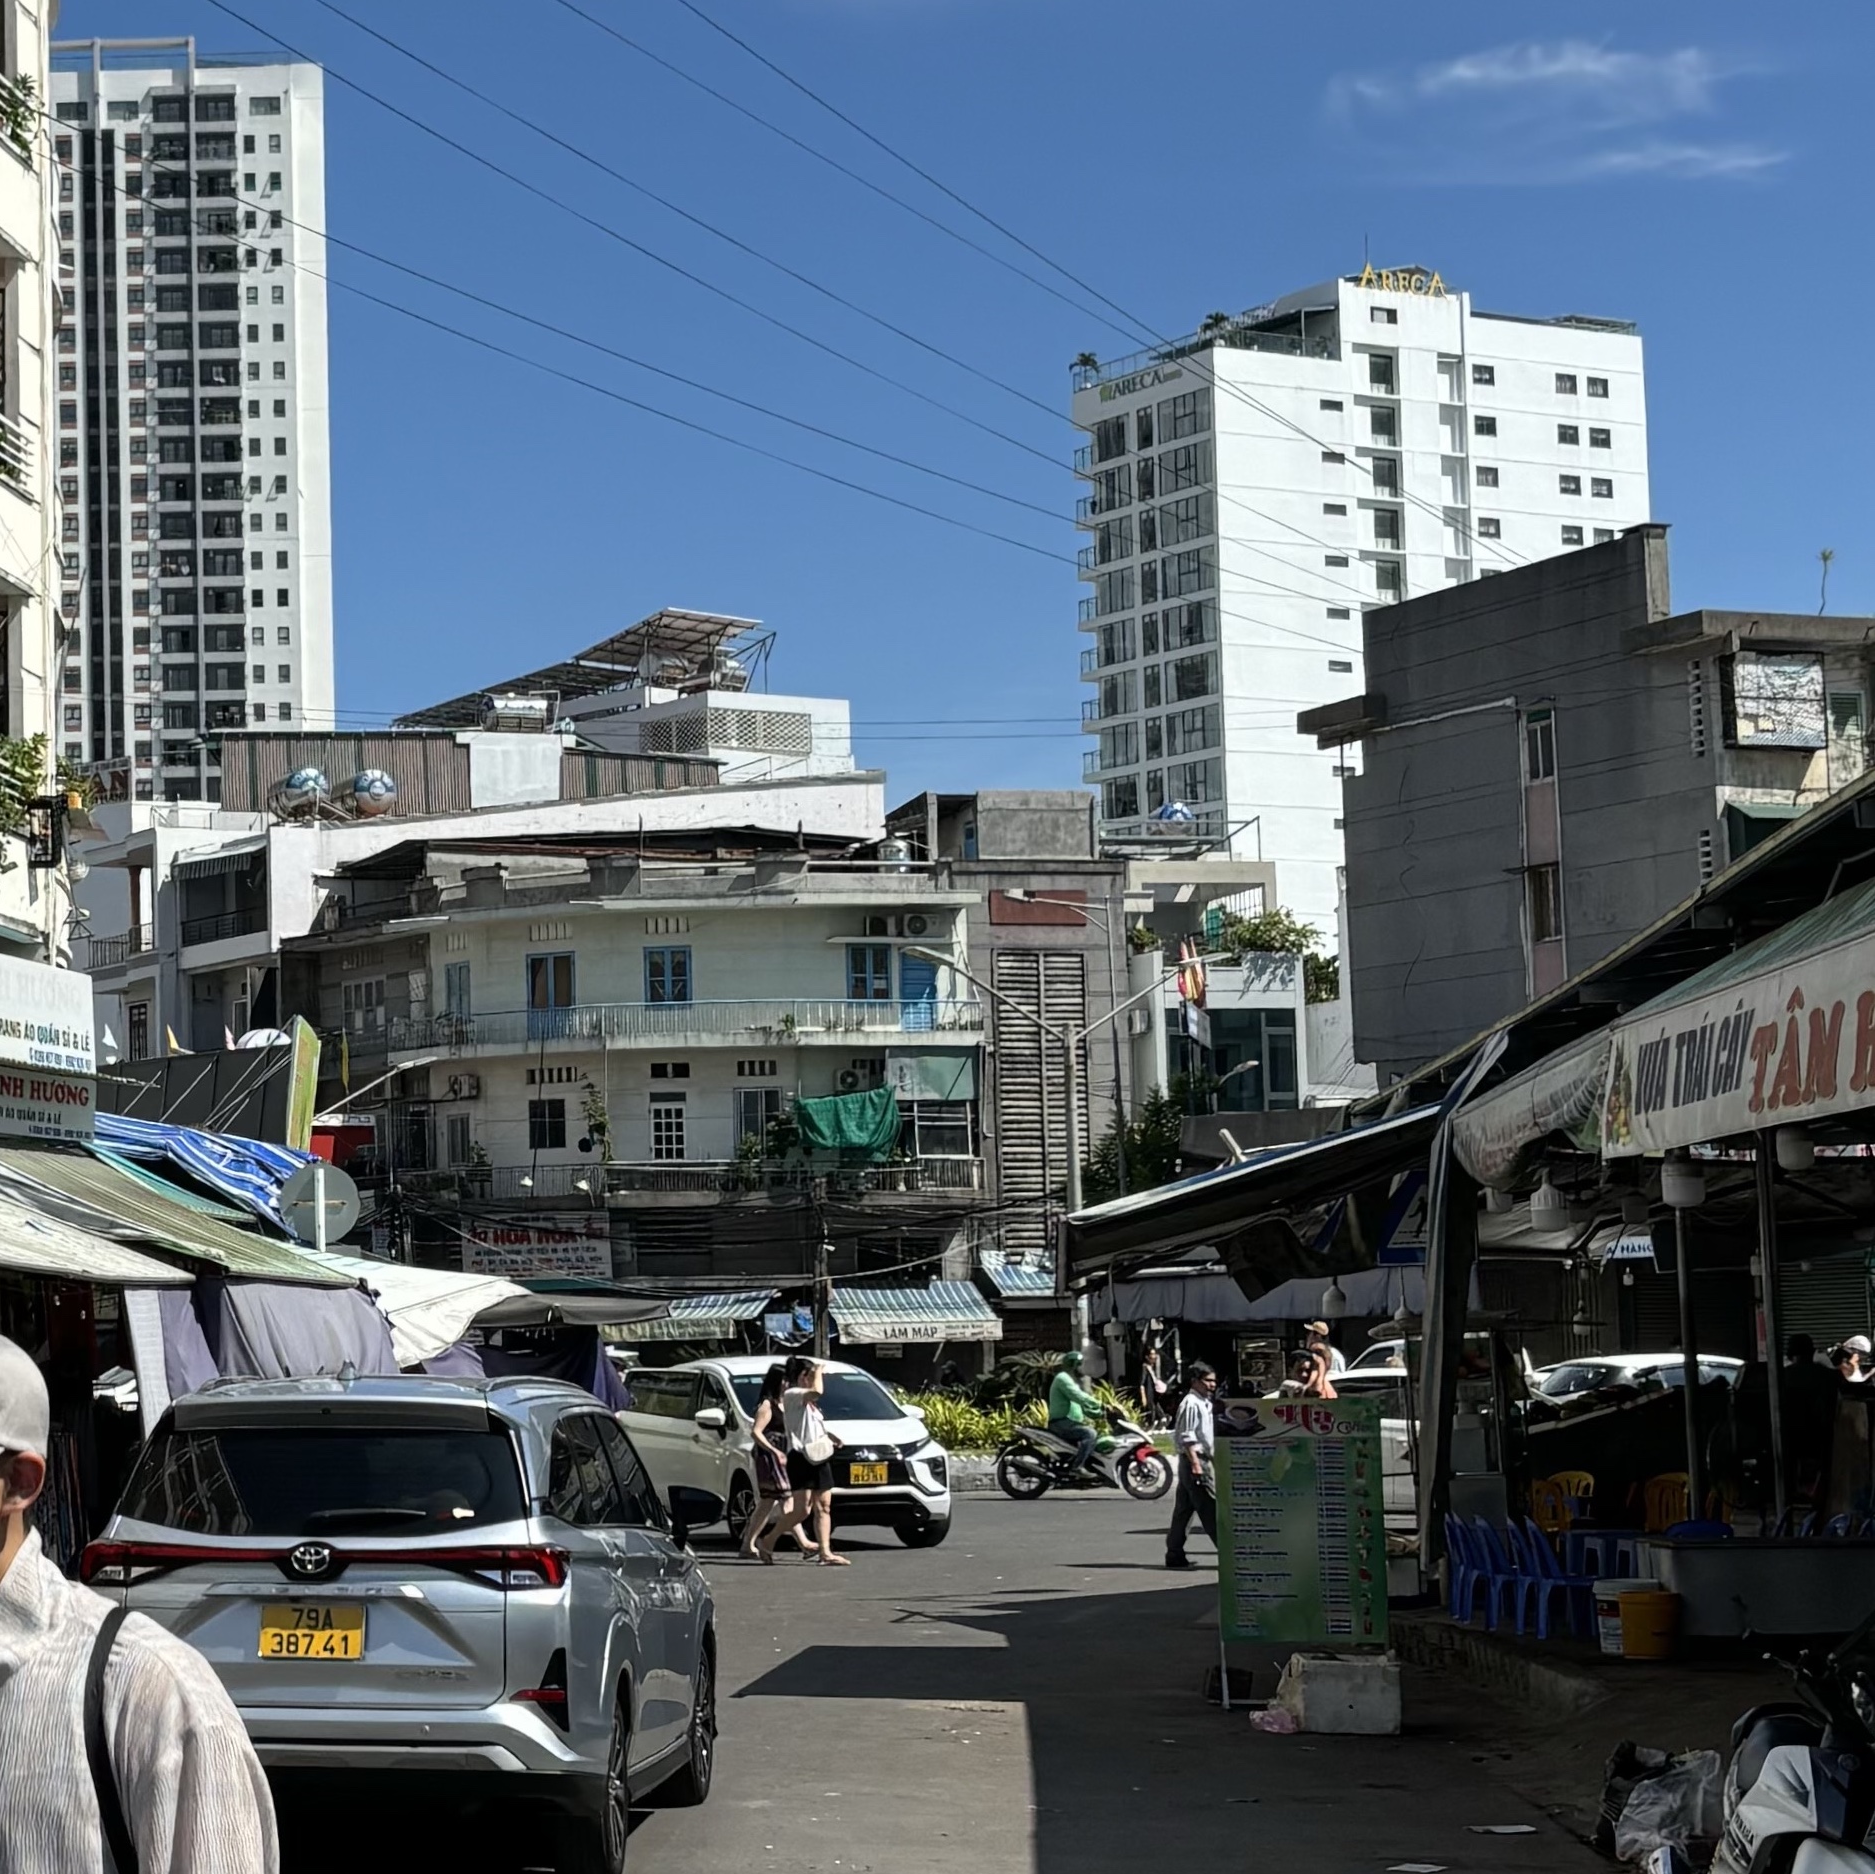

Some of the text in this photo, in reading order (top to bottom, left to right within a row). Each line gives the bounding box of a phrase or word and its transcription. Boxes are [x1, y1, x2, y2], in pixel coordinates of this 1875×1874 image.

[1359, 262, 1448, 299] ARECA
[1111, 367, 1165, 400] ARECA
[30, 1078, 90, 1107] HƯƠNG
[291, 1608, 334, 1630] 79A
[270, 1633, 350, 1656] 387.41
